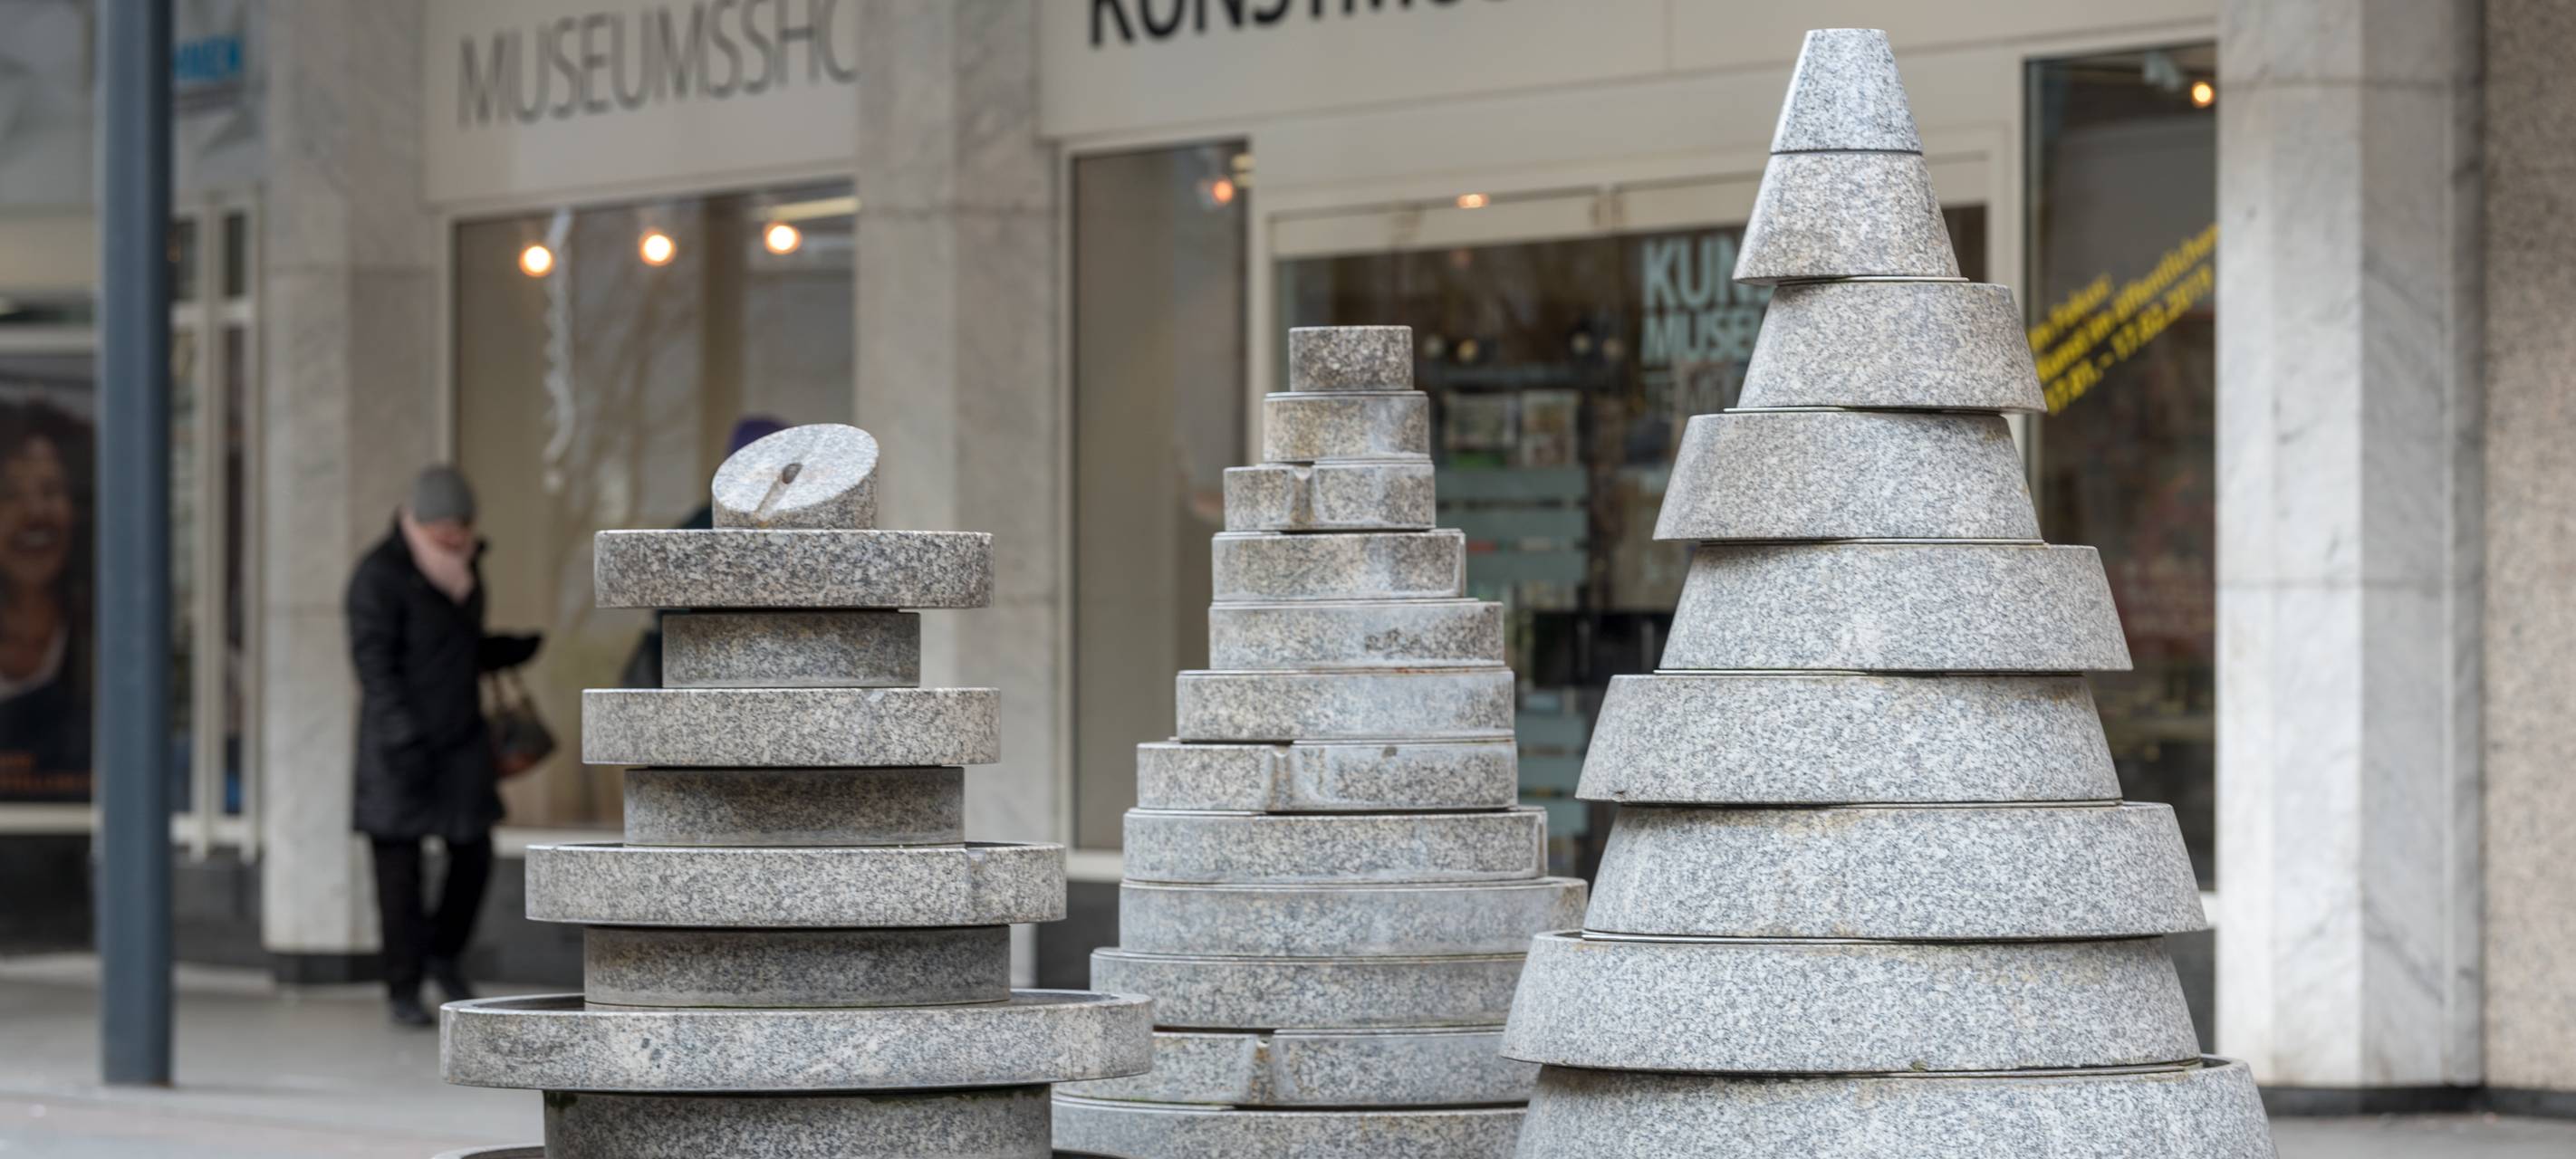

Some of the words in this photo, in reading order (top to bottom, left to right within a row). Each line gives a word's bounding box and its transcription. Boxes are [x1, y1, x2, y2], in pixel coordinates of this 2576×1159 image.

[457, 0, 860, 129] MUSEUMSSHO
[1643, 235, 1776, 308] KUN
[1642, 305, 1763, 366] MUSE
